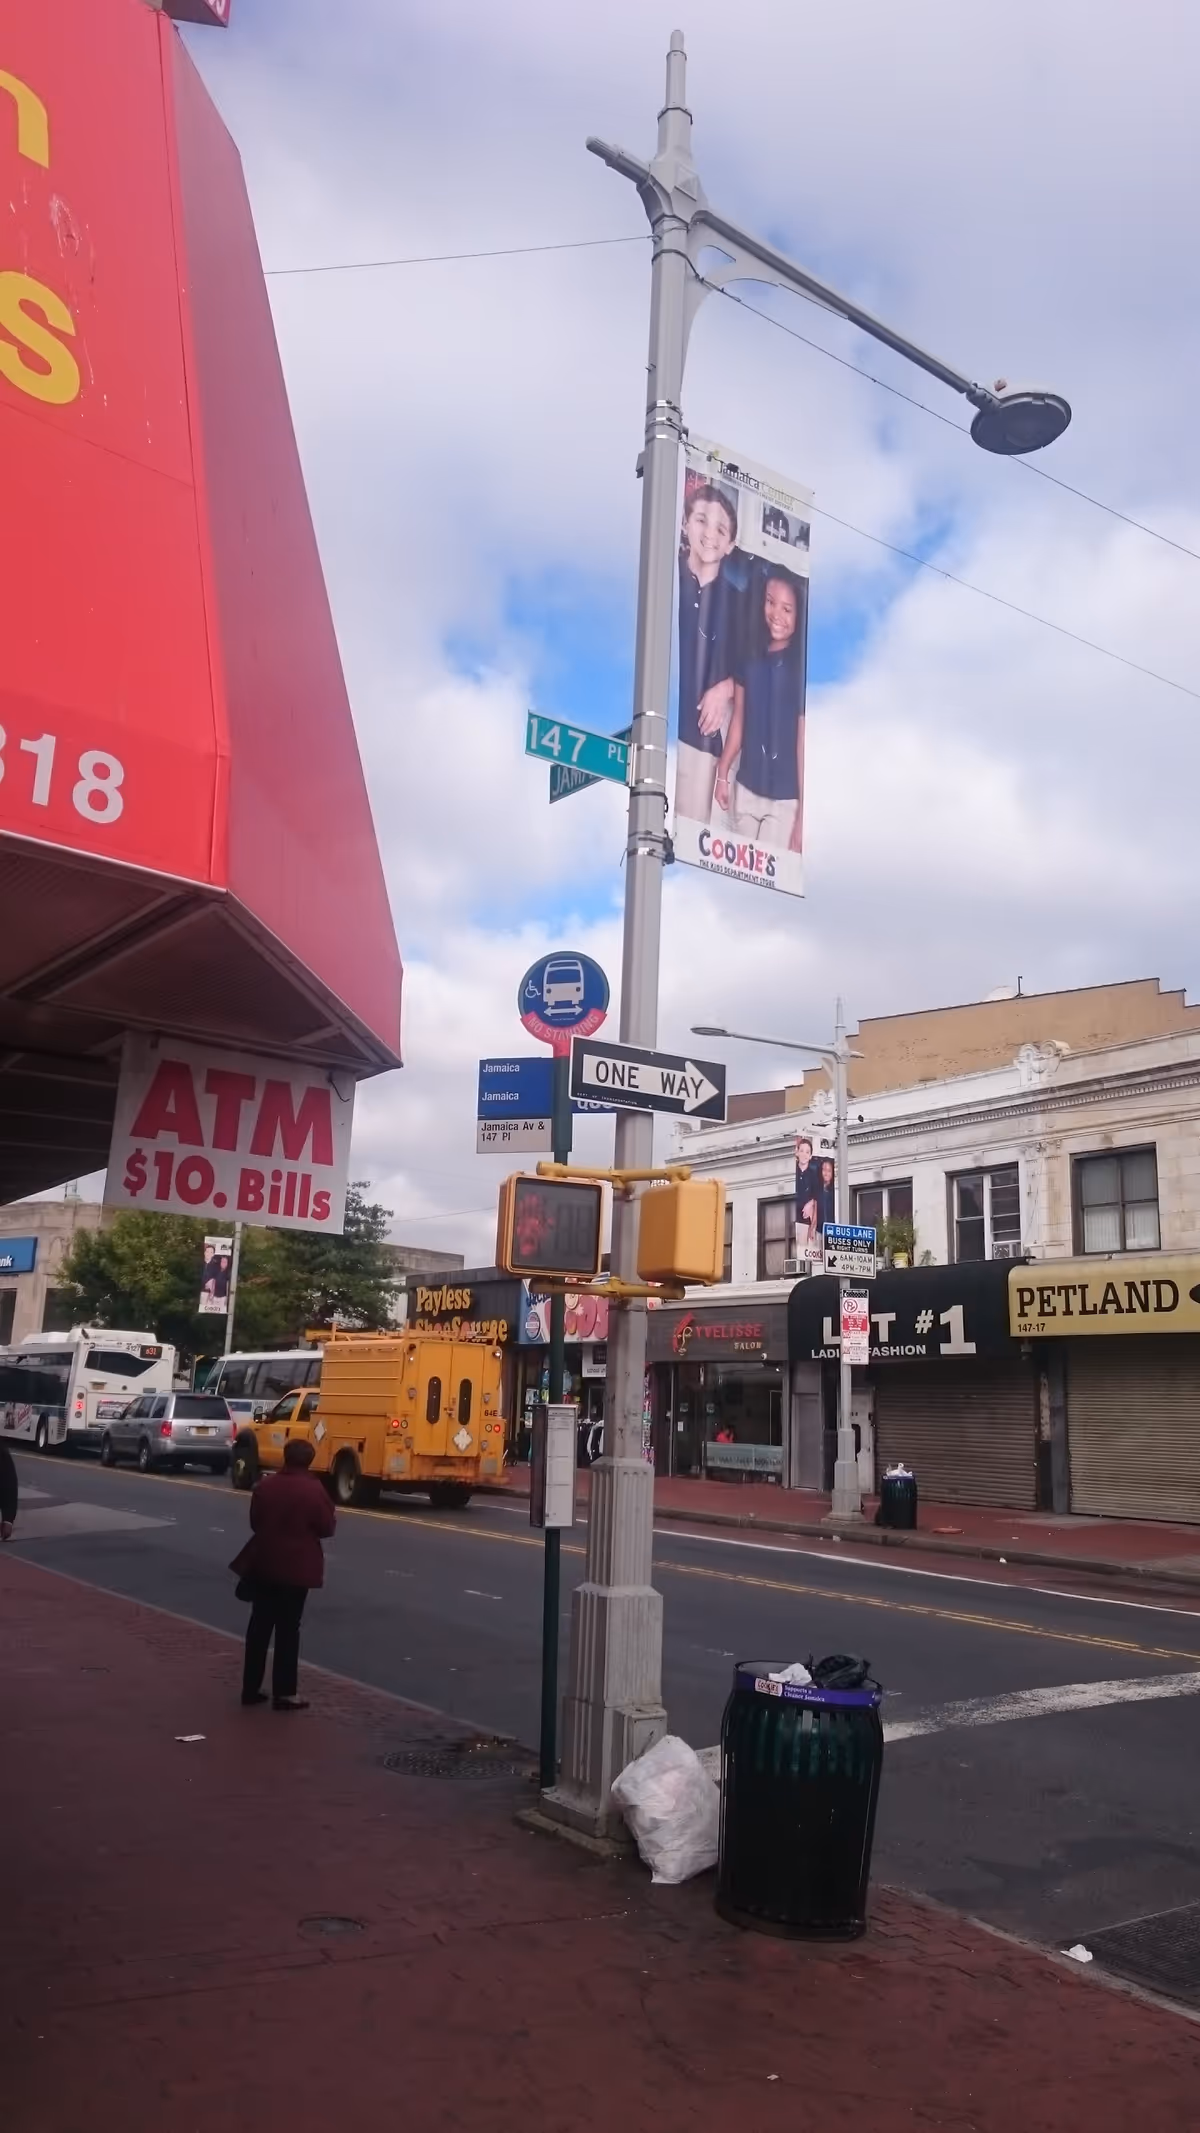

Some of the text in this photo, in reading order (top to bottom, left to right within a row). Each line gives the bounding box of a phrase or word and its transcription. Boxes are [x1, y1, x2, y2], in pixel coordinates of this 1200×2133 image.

[530, 718, 625, 763] 147 PL
[0, 724, 124, 824] 18
[527, 1013, 599, 1041] NO STANDING
[482, 1062, 520, 1073] Jamaica
[595, 1060, 704, 1100] ONE WAY
[481, 1091, 519, 1101] Jamaica
[129, 1058, 334, 1166] ATM
[481, 1120, 544, 1132] Jamaica Av &
[481, 1132, 511, 1142] 147 Pl
[123, 1148, 332, 1221] $10. Bills
[835, 1227, 873, 1239] BUS LANE
[828, 1236, 872, 1248] BUSES ONLY
[840, 1254, 873, 1264] 6AM-10AM
[841, 1264, 871, 1273] 4PM-7PM
[415, 1284, 471, 1317] Payless
[1016, 1279, 1180, 1318] PETLAND
[695, 1323, 762, 1339] YVELISSE
[822, 1304, 977, 1355] LT #1
[1017, 1323, 1046, 1333] 147-17
[734, 1341, 762, 1350] SALON
[811, 1349, 840, 1359] LADI
